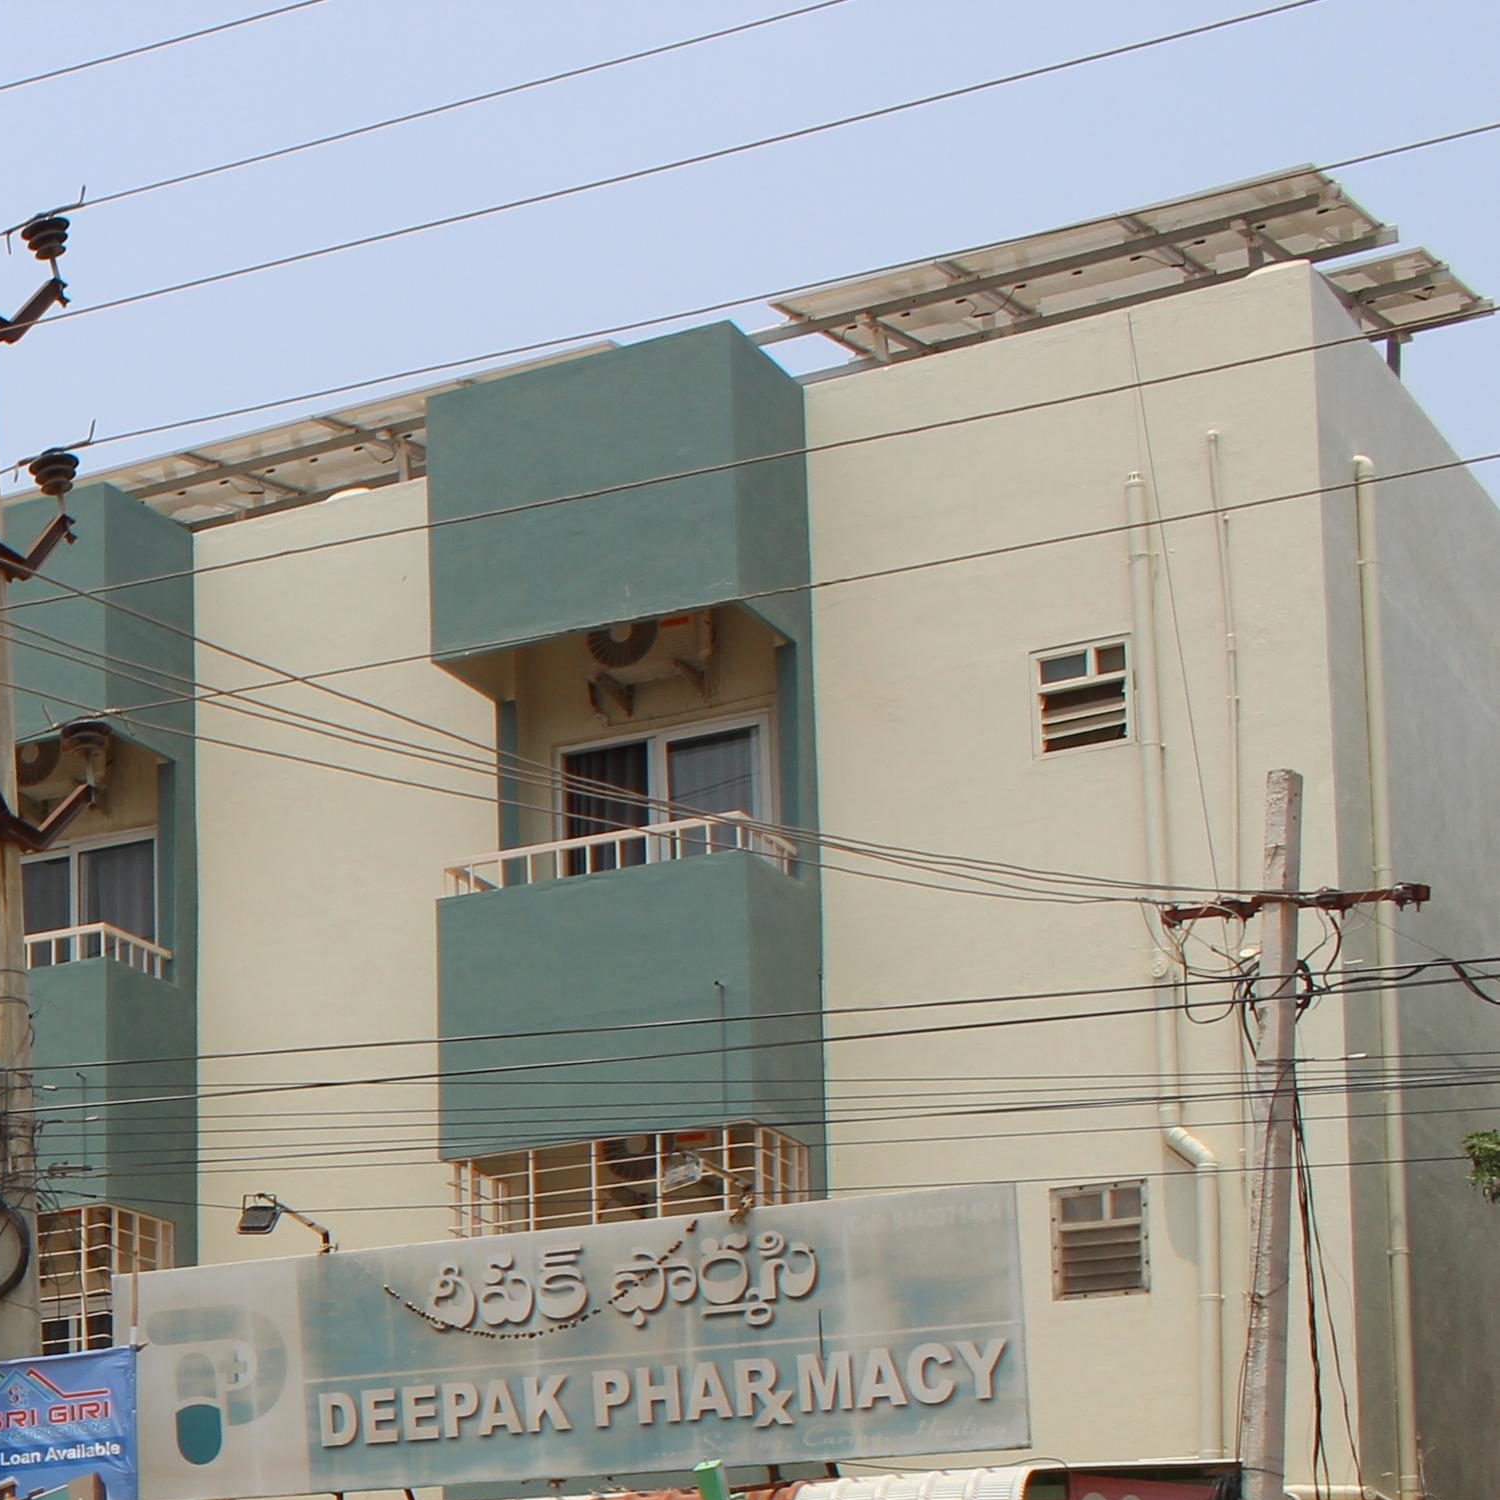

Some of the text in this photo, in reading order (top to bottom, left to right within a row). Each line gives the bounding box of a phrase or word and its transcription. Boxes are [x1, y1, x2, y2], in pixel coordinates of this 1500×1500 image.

[48, 1400, 111, 1424] GIRI
[318, 1374, 572, 1448] DEEPAK
[1, 1449, 41, 1466] Loan
[45, 1441, 121, 1462] Available
